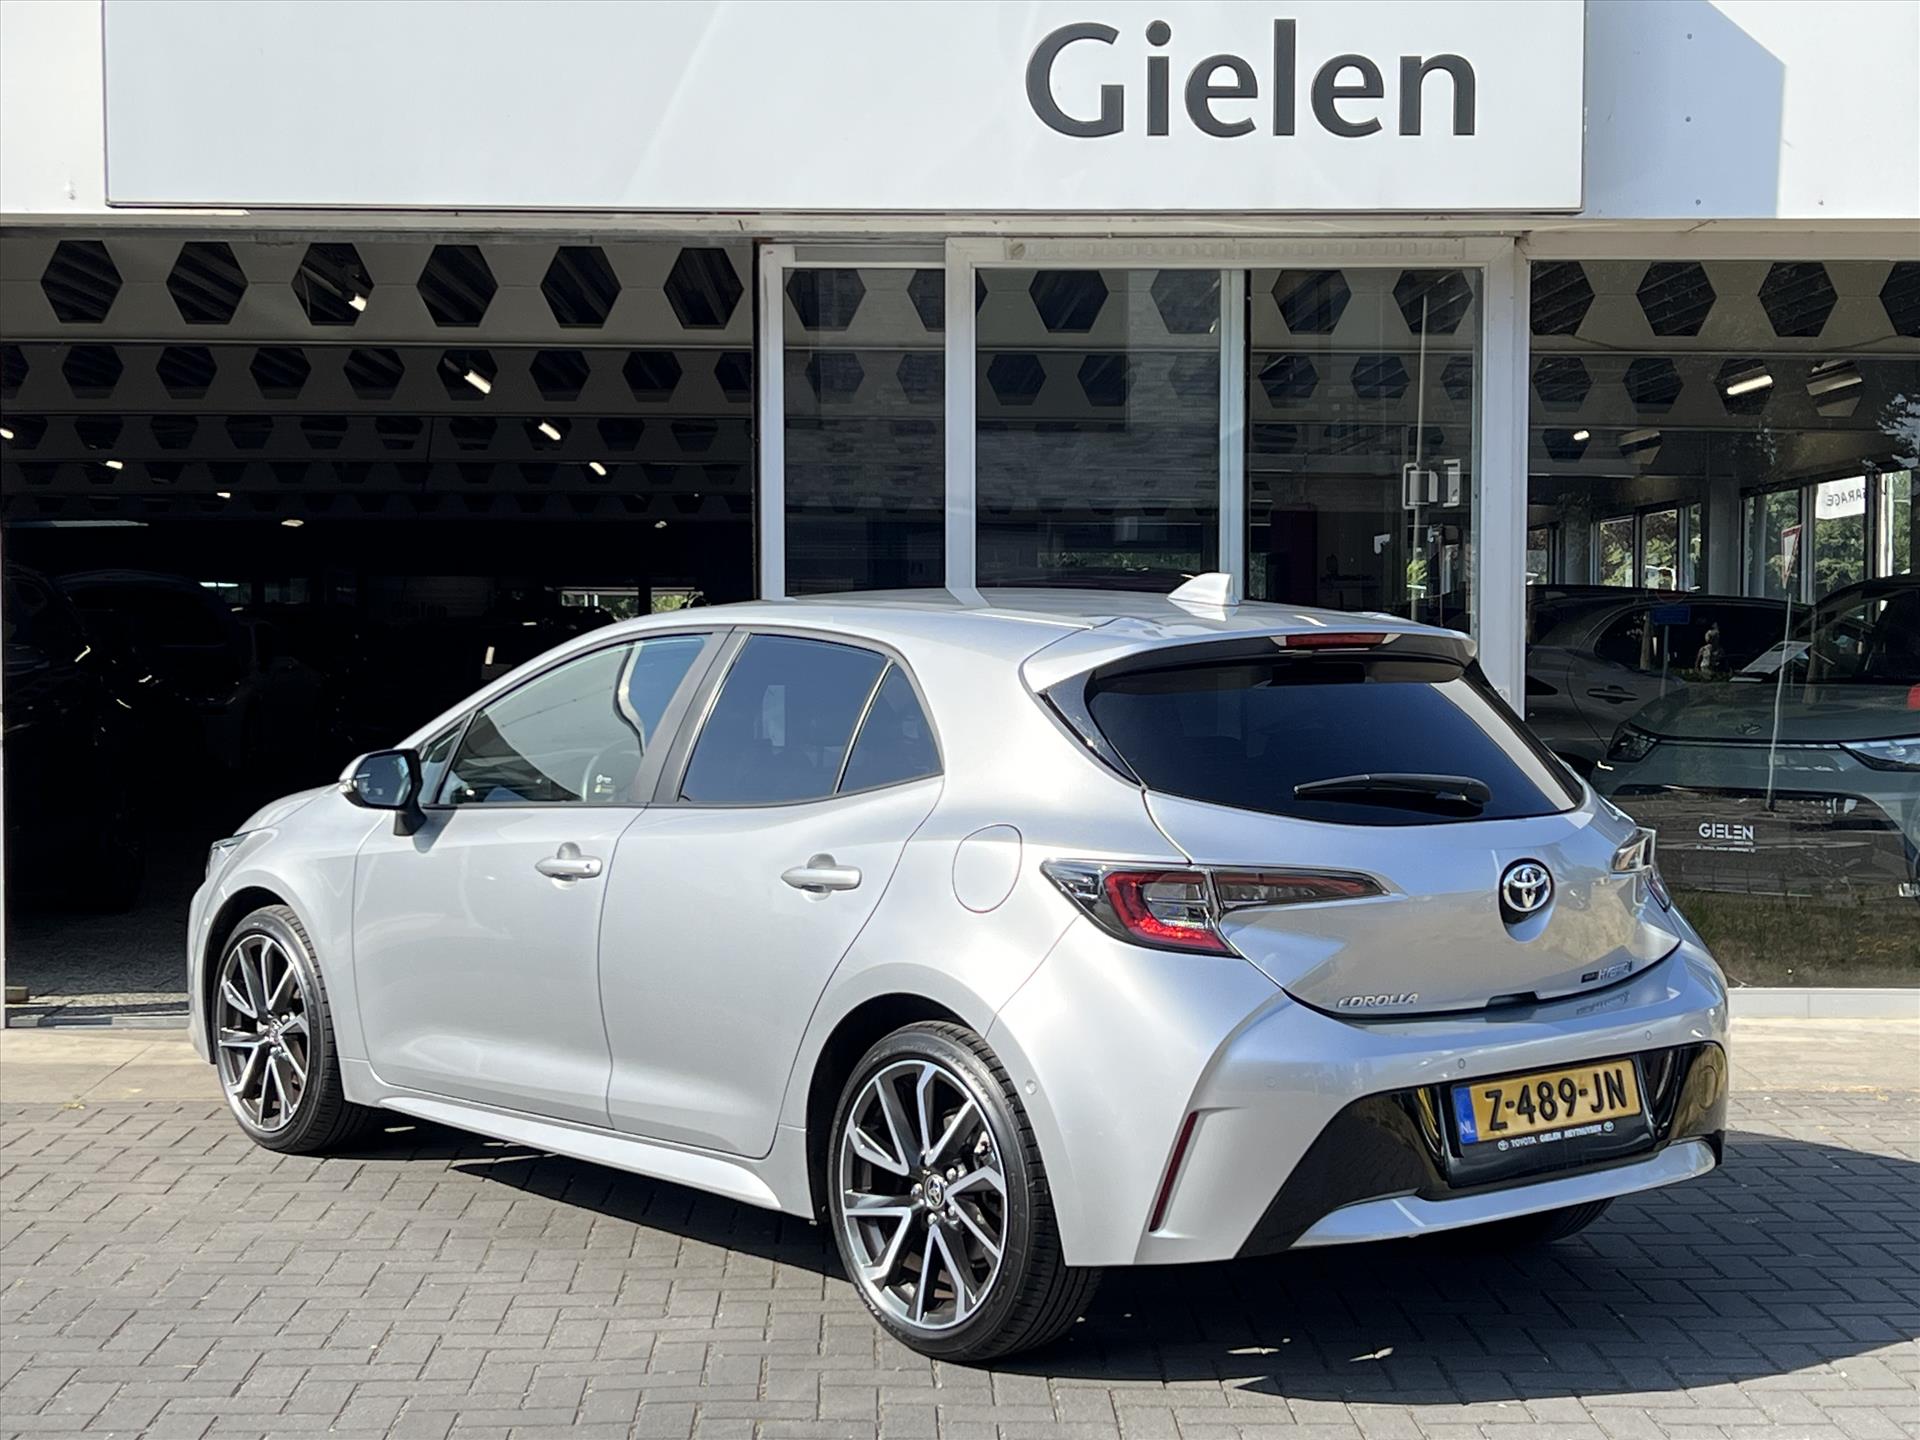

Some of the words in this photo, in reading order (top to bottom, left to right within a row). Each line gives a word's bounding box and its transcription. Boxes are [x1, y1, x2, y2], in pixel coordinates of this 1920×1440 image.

[1026, 18, 1476, 138] Gielen
[1698, 822, 1754, 840] GIELEN
[1337, 992, 1419, 1008] COROLLA
[1484, 1068, 1628, 1131] Z-489-JN
[1459, 1120, 1475, 1134] NL
[1510, 1136, 1537, 1147] TOYOTA
